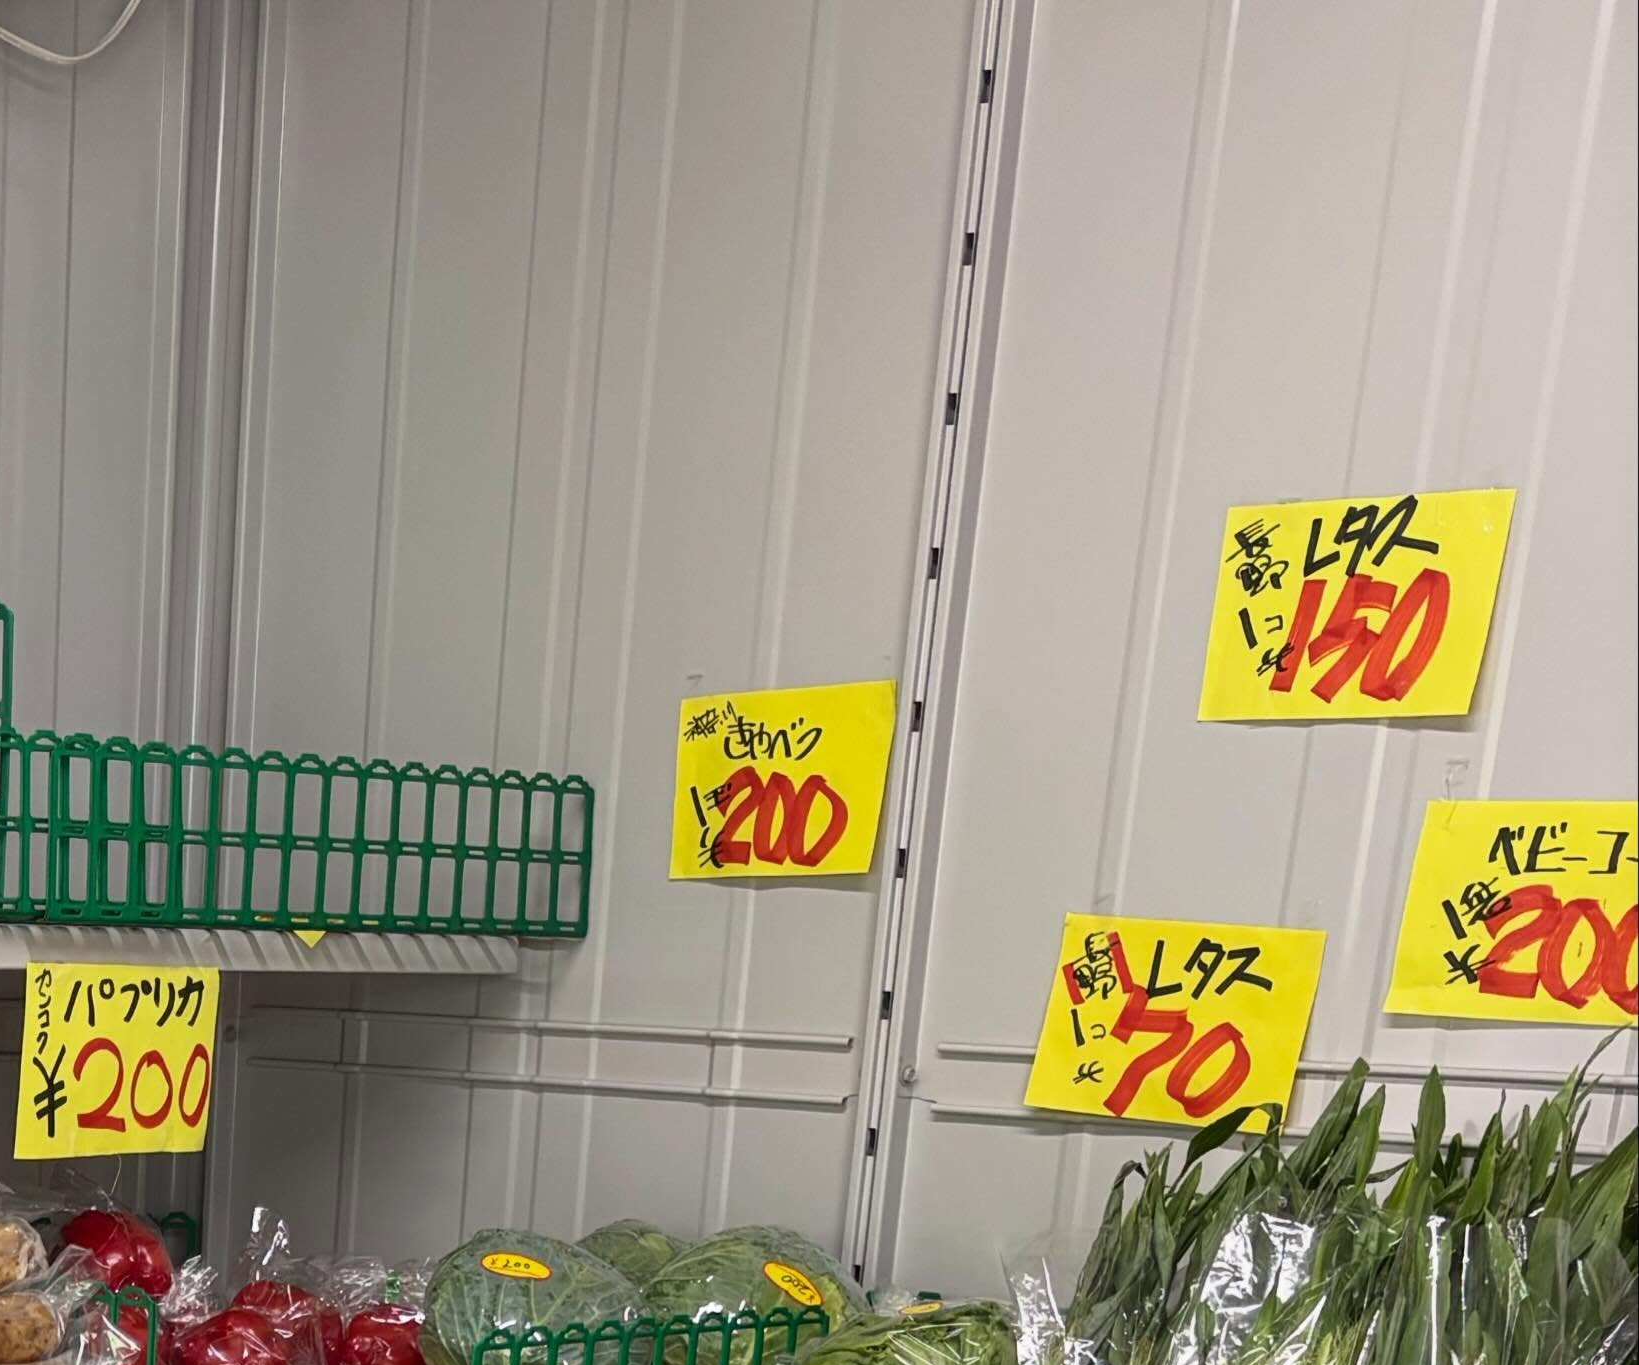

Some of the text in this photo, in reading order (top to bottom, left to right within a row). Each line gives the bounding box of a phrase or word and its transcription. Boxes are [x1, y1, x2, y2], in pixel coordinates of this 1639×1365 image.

[1303, 494, 1439, 578] レタス
[1146, 937, 1273, 1001] レタス
[63, 975, 205, 1028] パプリカ
